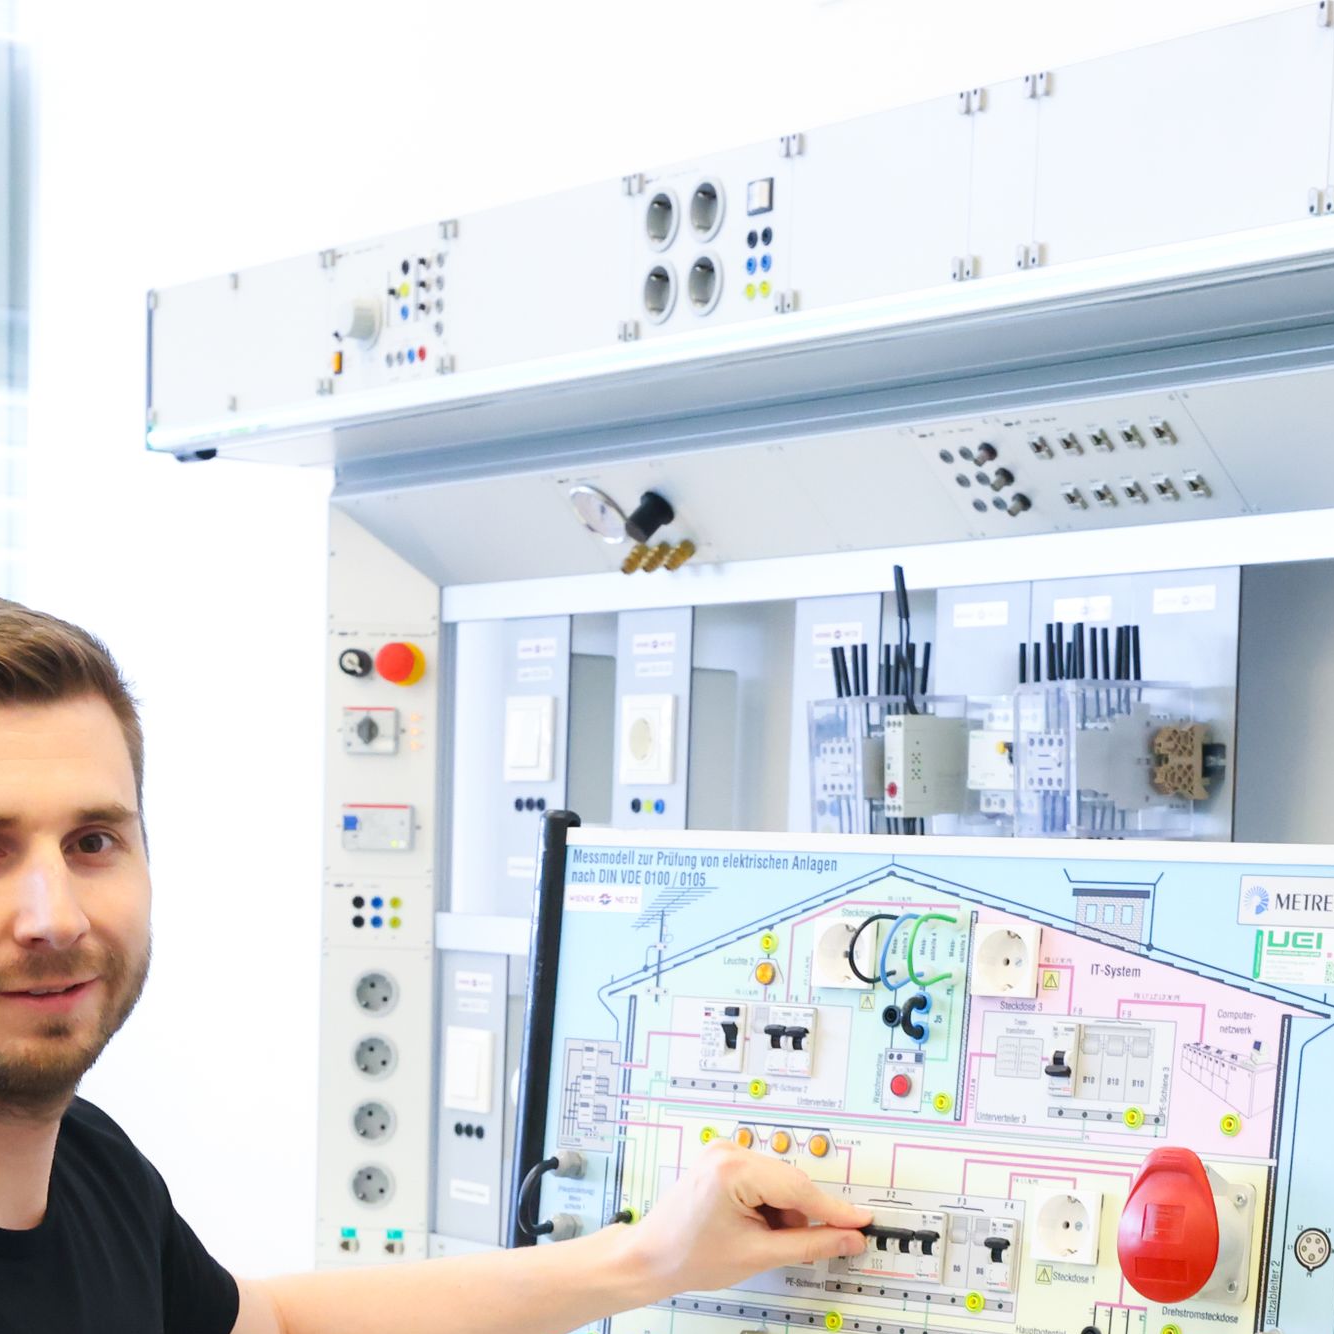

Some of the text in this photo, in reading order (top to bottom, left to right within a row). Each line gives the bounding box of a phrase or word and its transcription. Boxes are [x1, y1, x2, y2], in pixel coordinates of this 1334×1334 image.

[573, 849, 838, 872] Messmodell zur Prüfung von elektrischen Anlagen
[571, 871, 596, 884] nach
[599, 872, 617, 885] DIN
[620, 872, 641, 885] VDE
[644, 873, 670, 886] 0100
[680, 874, 706, 888] 0105
[569, 894, 639, 905] WIENER NETZE
[1090, 963, 1141, 979] IT-System
[1000, 1001, 1034, 1012] Steckdose
[1217, 1009, 1257, 1022] Computer-
[1219, 1024, 1252, 1036] netzwerk
[1053, 1271, 1088, 1284] Steckdose
[1266, 1269, 1280, 1325] Blitzableiter
[1162, 1306, 1238, 1324] Drehstromsteckdose
